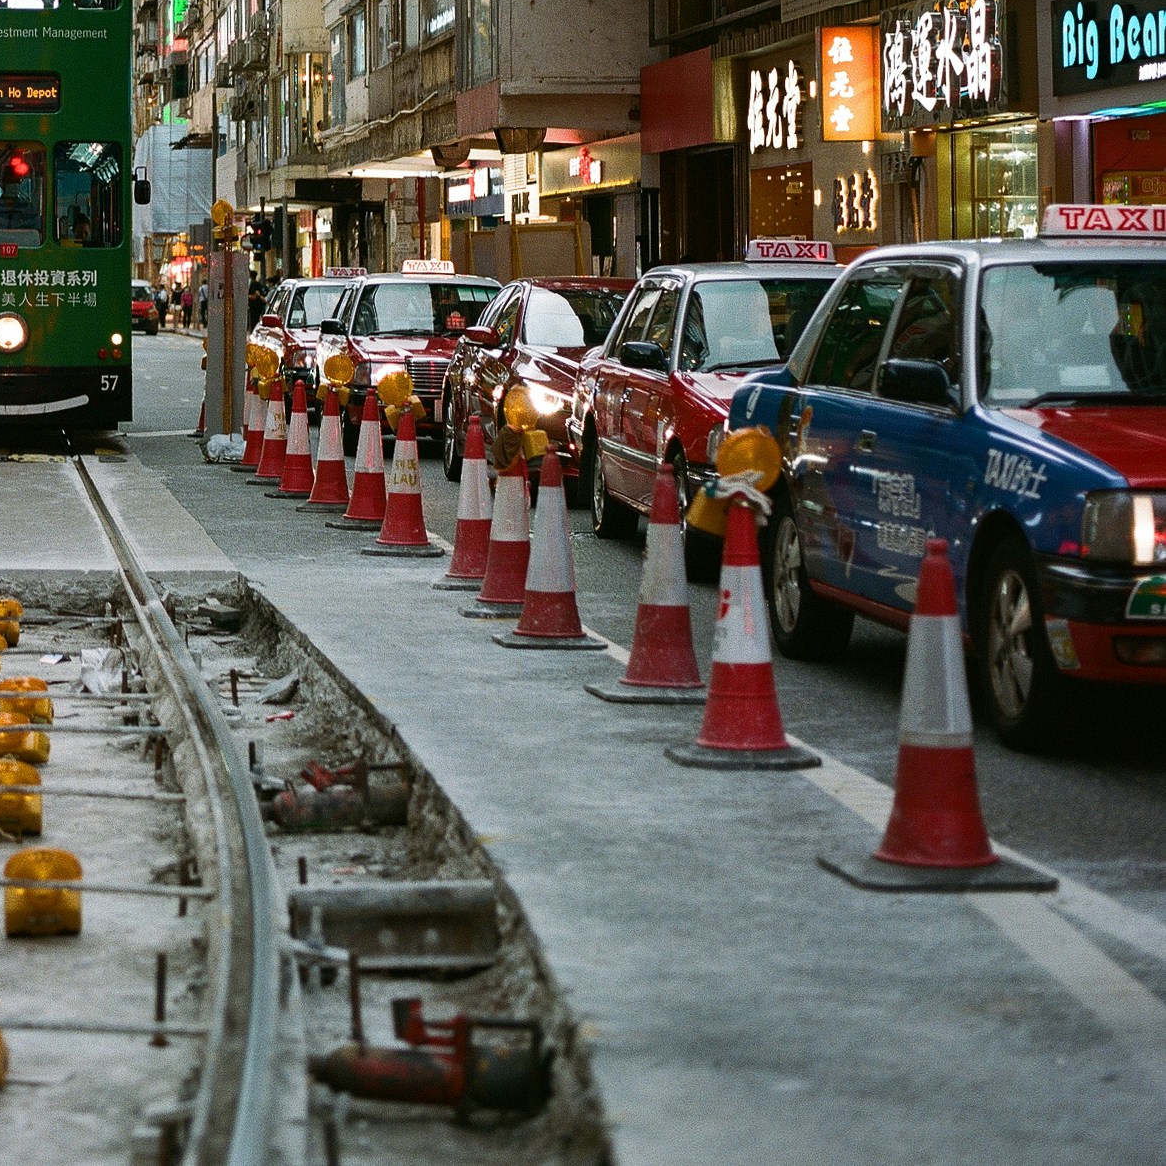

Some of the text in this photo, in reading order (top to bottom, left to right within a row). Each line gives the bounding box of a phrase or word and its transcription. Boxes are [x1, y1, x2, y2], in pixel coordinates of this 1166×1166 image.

[42, 27, 108, 40] Management
[1062, 1, 1099, 80] Big
[8, 87, 21, 98] Ho
[27, 87, 57, 99] Depot
[1059, 207, 1166, 231] TAXI
[757, 242, 828, 258] TAXI
[331, 268, 365, 277] TAXI
[406, 261, 450, 272] TAXI
[0, 269, 98, 287] 退休投資系列
[100, 375, 119, 391] 57
